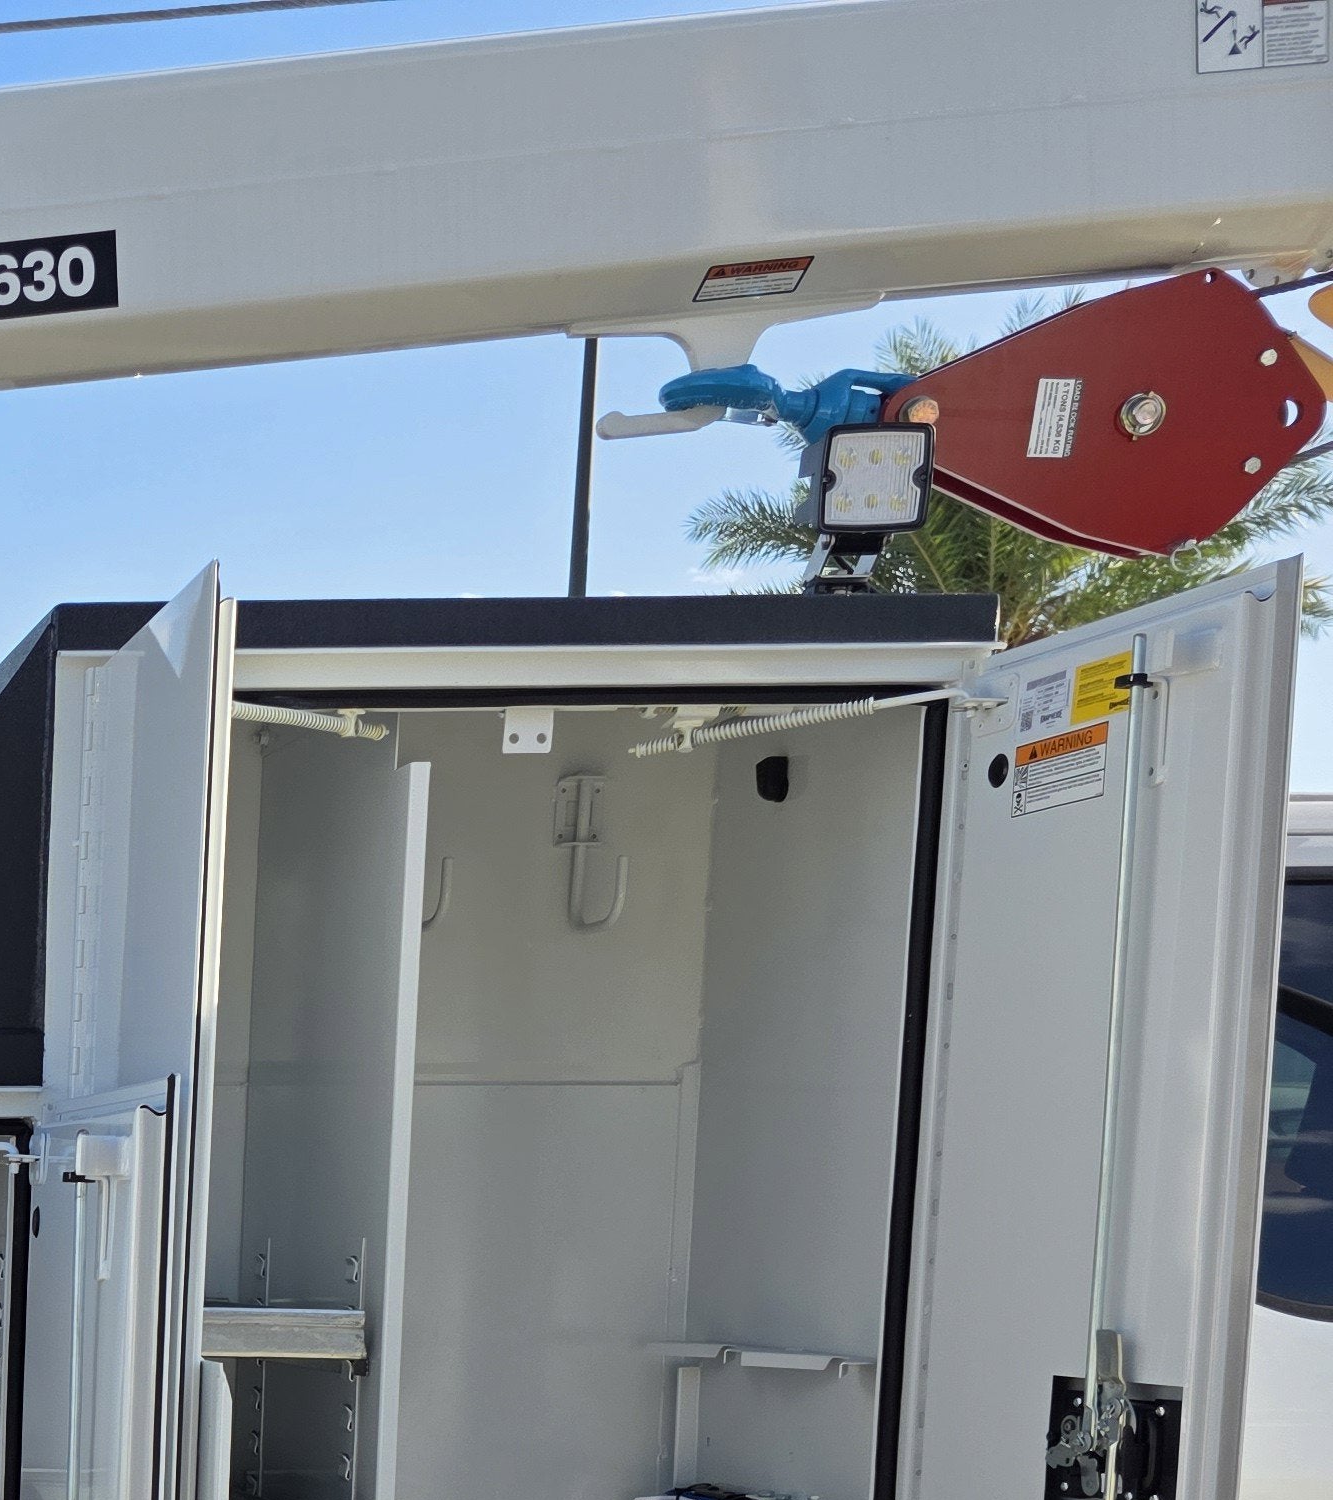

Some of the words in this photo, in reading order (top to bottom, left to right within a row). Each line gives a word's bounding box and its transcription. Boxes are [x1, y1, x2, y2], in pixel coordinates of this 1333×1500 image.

[730, 260, 799, 275] WARNING
[1058, 388, 1069, 413] TONS
[1073, 380, 1083, 401] LOAD
[1068, 402, 1078, 428] BLOCK
[1063, 429, 1074, 457] RATING
[1040, 730, 1093, 757] WARNING
